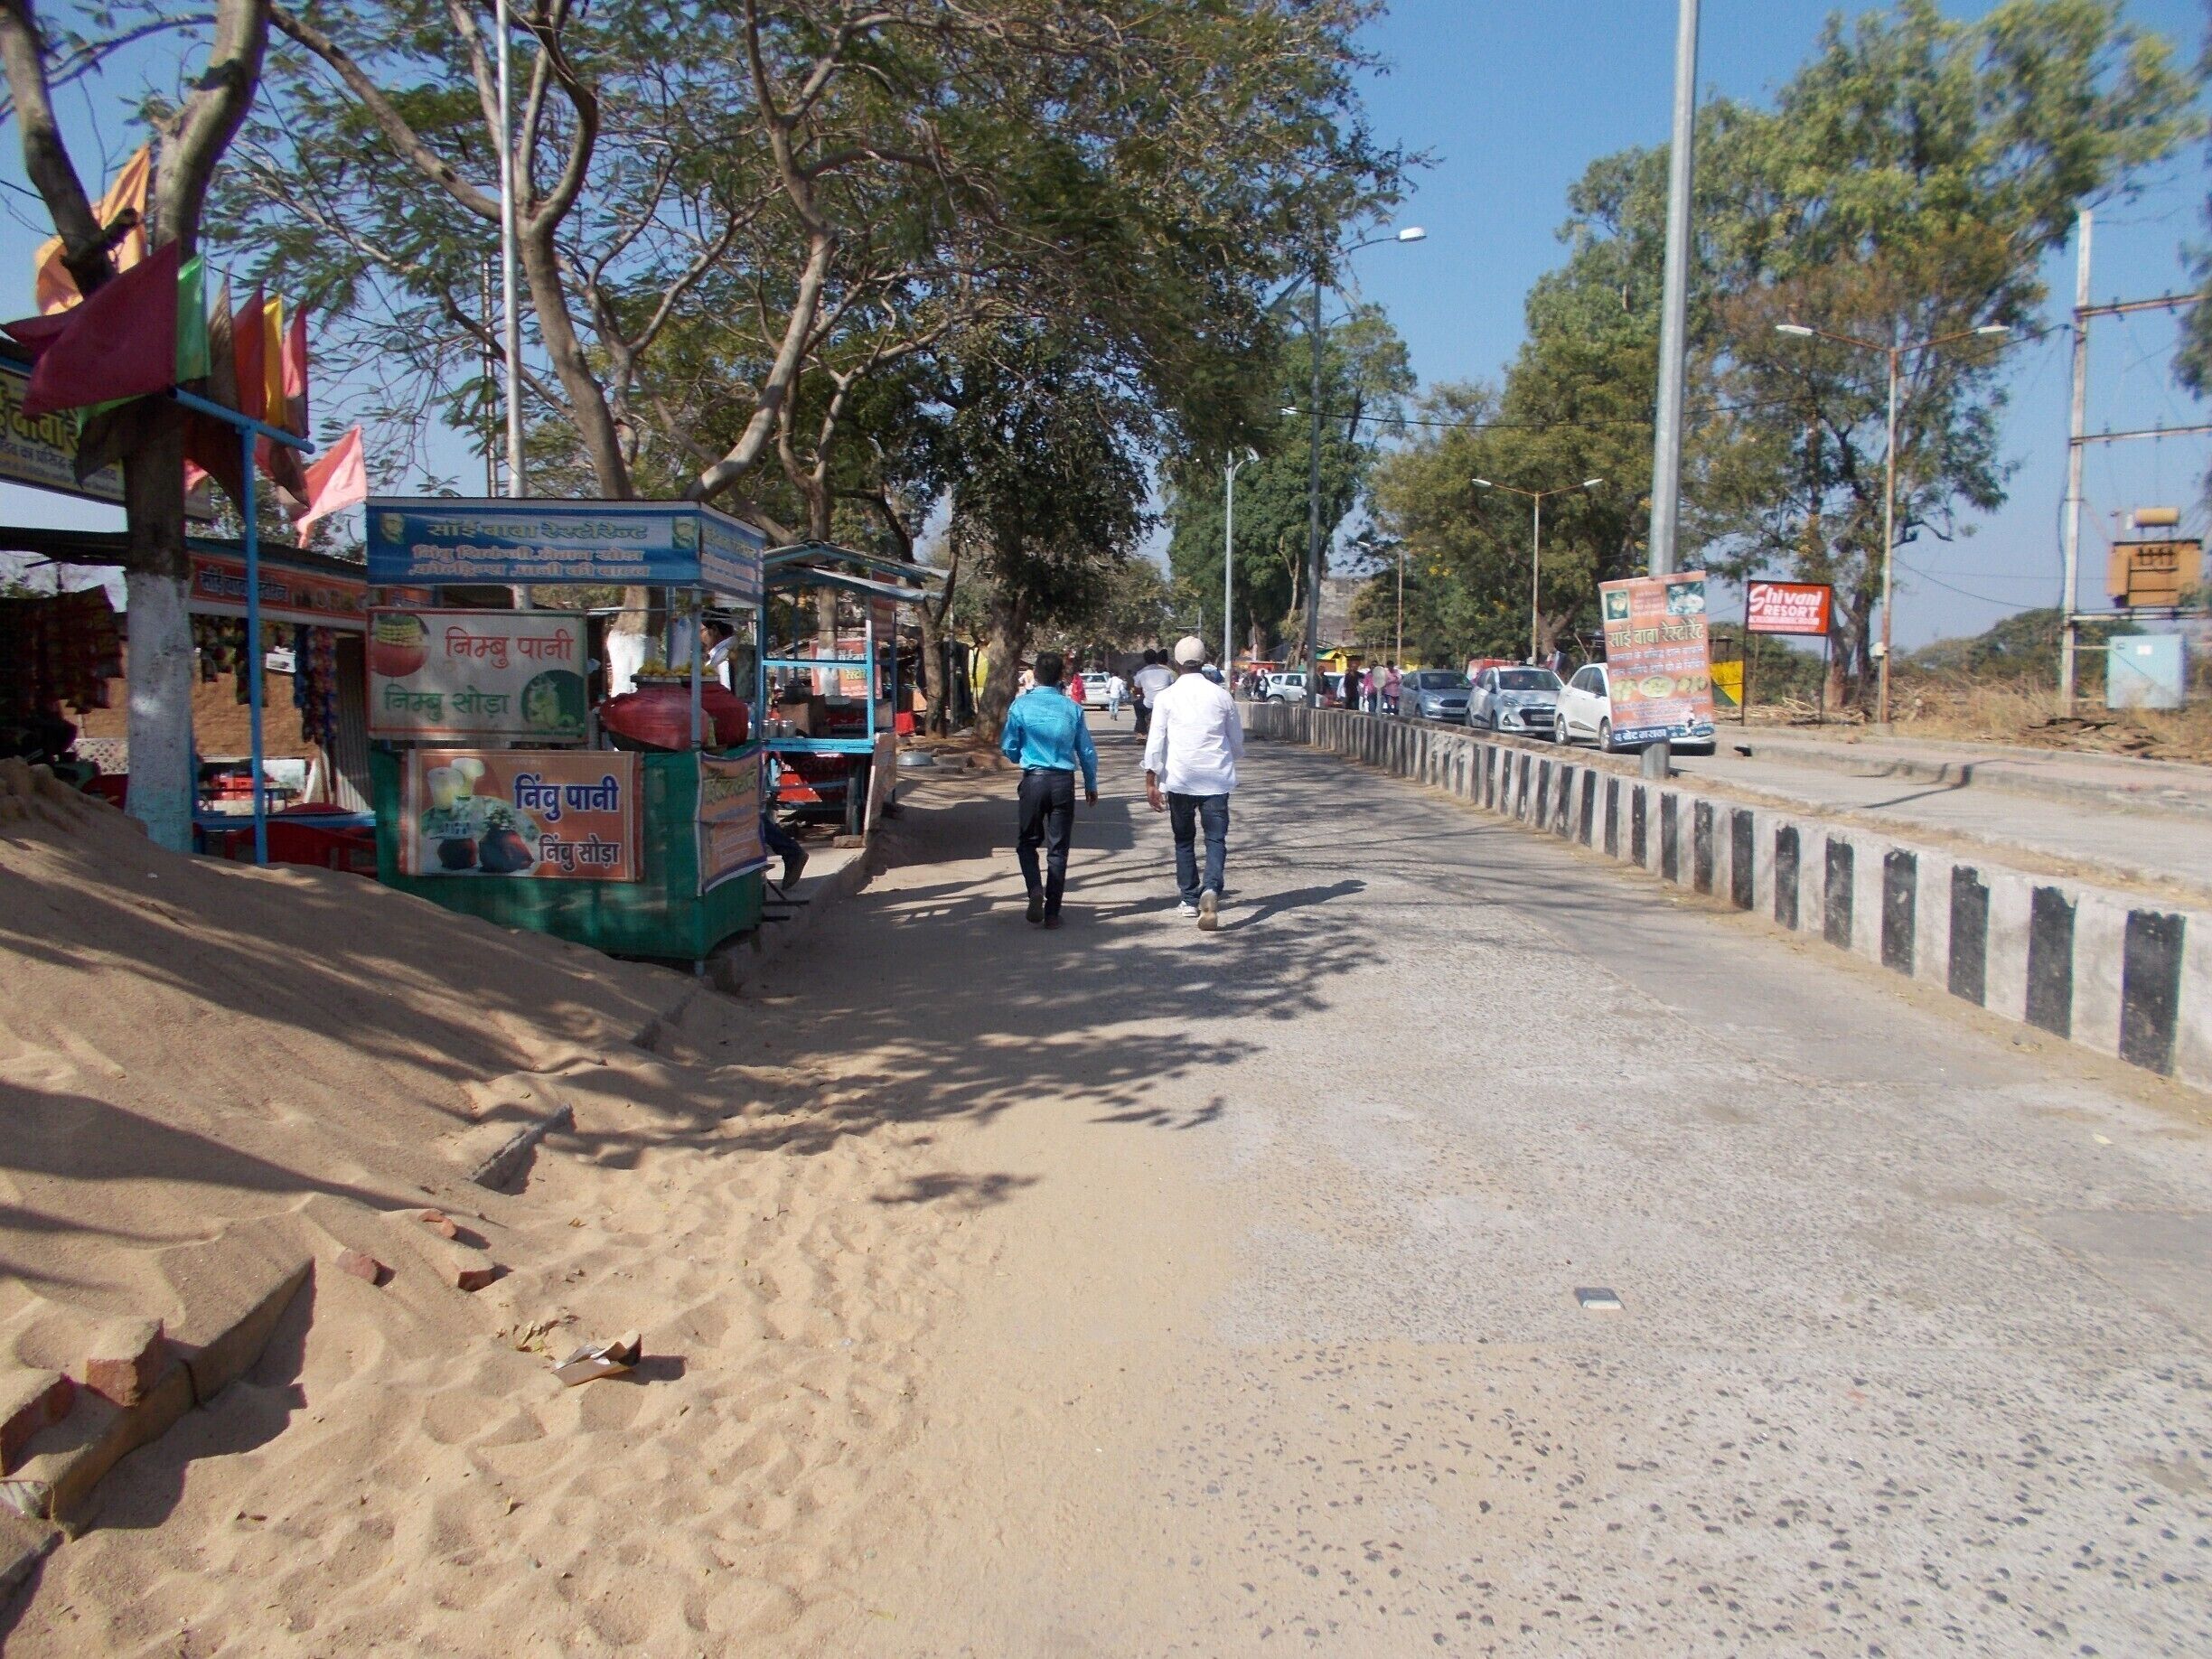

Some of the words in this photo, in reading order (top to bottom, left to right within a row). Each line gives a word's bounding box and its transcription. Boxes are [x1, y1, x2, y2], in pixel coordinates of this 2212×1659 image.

[481, 523, 538, 539] बाबा
[1749, 584, 1823, 614] Shivani
[1763, 604, 1819, 617] RESORT
[445, 626, 510, 668] निम्बु
[517, 628, 575, 661] पानी
[1634, 628, 1659, 645] बाबा
[384, 684, 445, 721] निम्बु
[566, 776, 619, 811] पानी
[578, 833, 619, 867] सोड़ा
